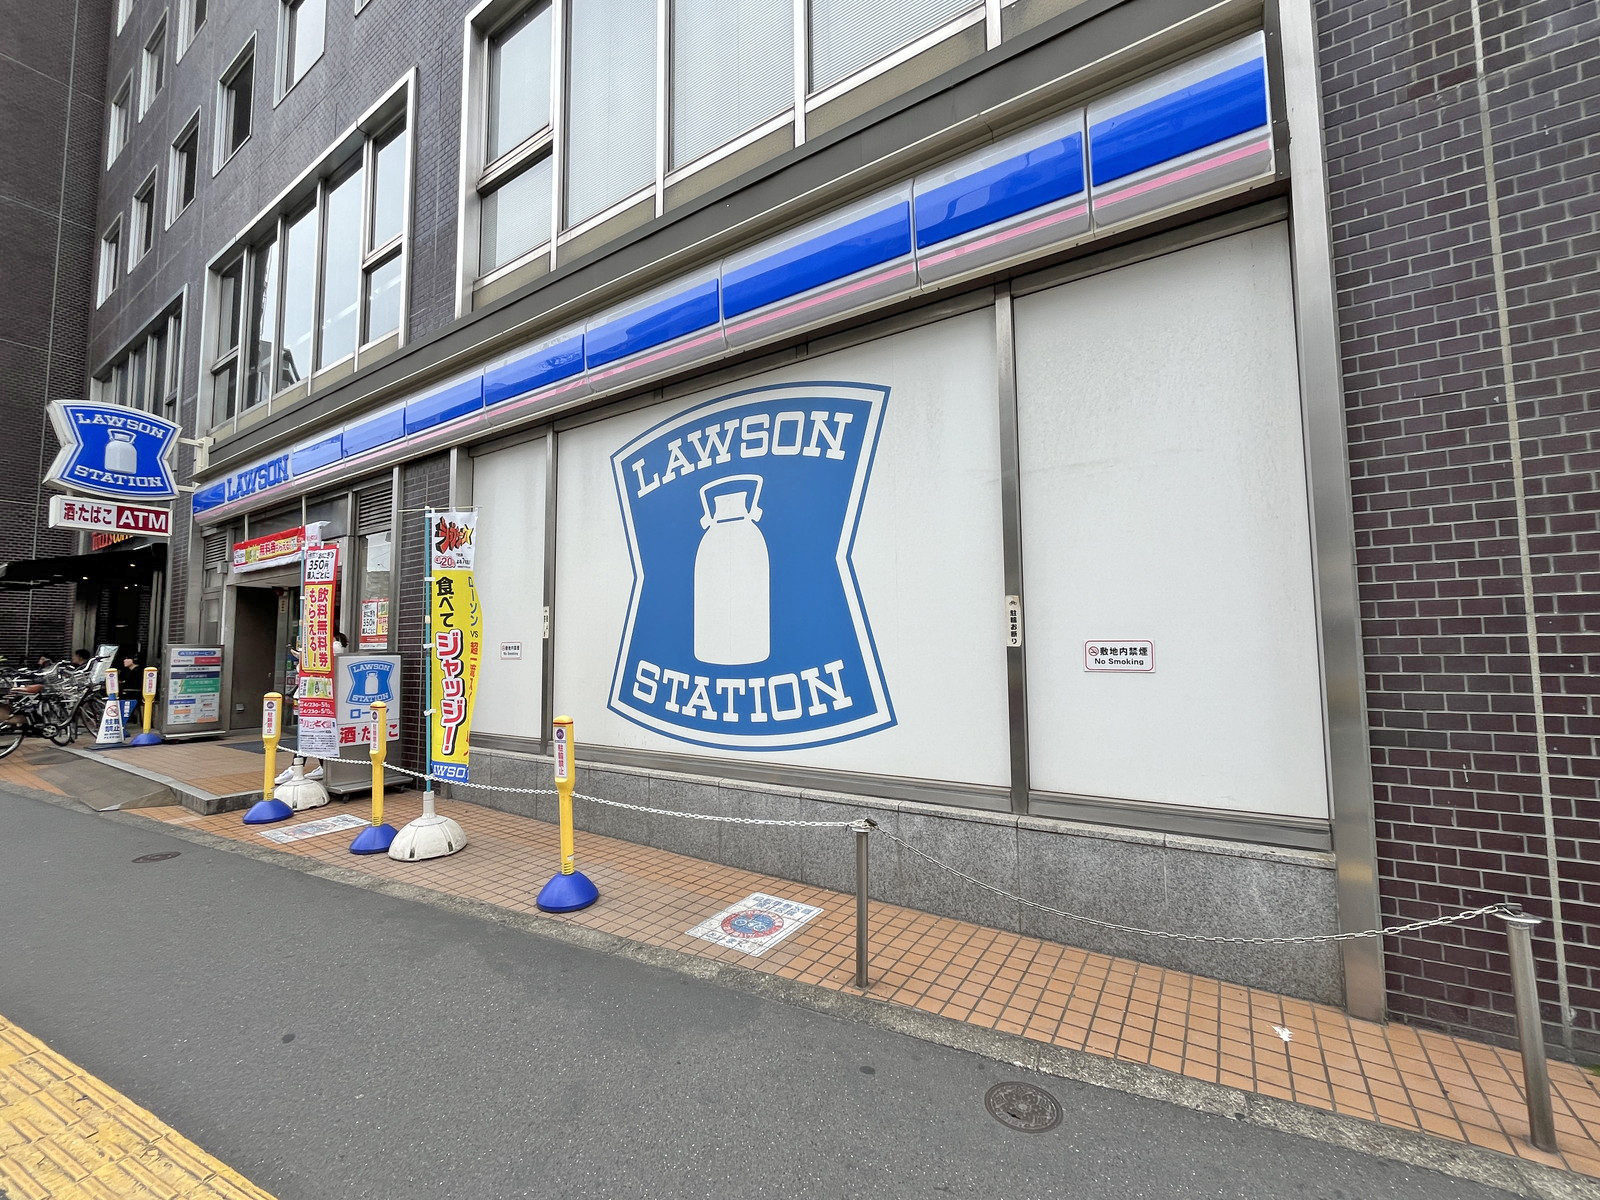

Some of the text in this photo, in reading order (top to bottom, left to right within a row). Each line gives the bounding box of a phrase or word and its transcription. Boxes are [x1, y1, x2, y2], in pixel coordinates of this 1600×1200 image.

[76, 413, 166, 439] LAWSON
[632, 411, 853, 499] LAWSON
[74, 465, 164, 488] STATION
[226, 453, 289, 502] LAWSON
[63, 502, 167, 531] 酒・たばこ ATM
[309, 560, 330, 570] 350円
[468, 576, 479, 627] ローソン
[309, 588, 317, 668] もらえる!
[317, 588, 329, 668] 飲料無料券
[1100, 647, 1148, 656] 敷地内禁煙
[1109, 658, 1144, 666] Smoking
[353, 662, 390, 674] LAWSON
[351, 693, 389, 703] STATION
[632, 659, 854, 723] STATION
